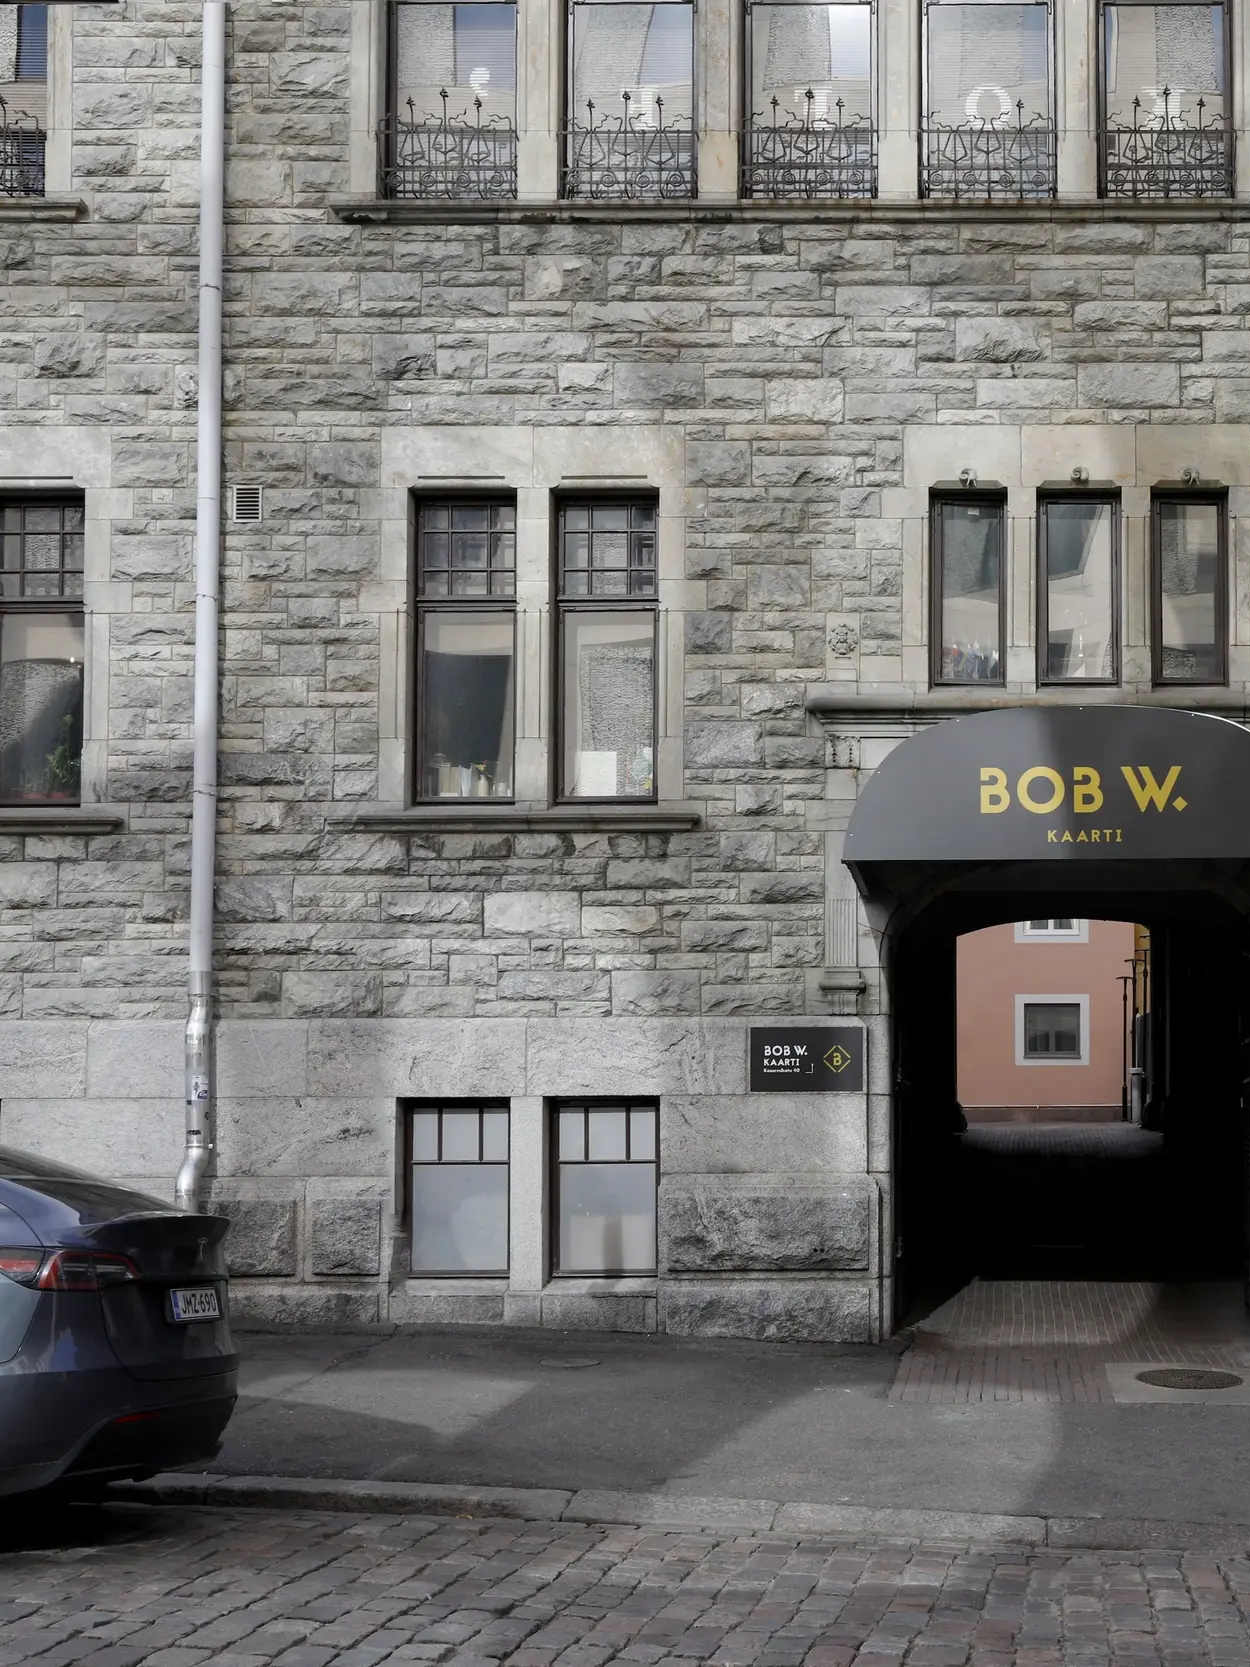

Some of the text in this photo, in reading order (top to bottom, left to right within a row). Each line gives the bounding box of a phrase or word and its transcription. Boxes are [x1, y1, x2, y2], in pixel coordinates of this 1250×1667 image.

[980, 765, 1188, 814] BOB W.
[1047, 829, 1122, 843] KAARTI
[764, 1045, 808, 1056] BOB W.
[763, 1058, 800, 1066] KAARTI
[181, 1293, 217, 1315] JMZ-690
